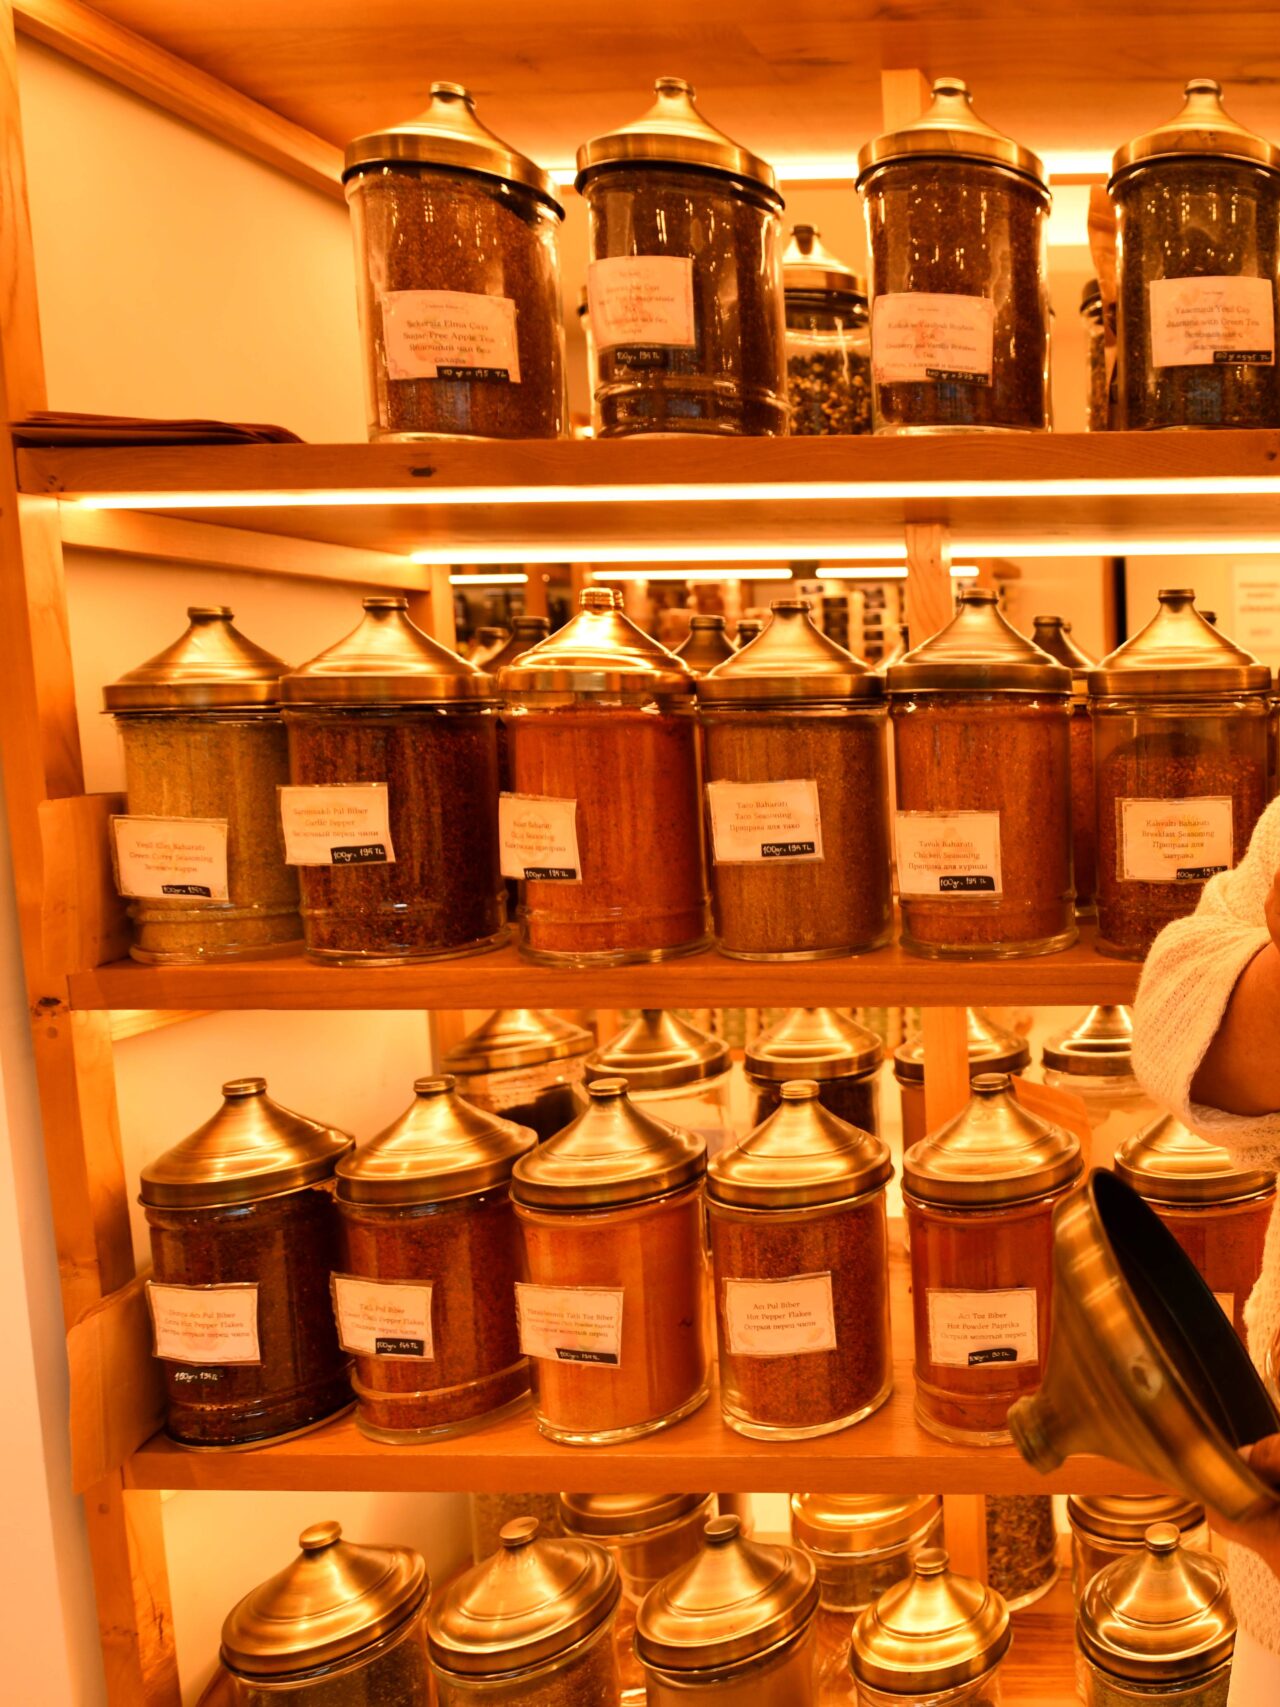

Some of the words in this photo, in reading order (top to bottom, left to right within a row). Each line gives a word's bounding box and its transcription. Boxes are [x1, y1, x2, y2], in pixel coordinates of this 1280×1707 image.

[780, 1301, 801, 1309] Biber
[761, 1312, 786, 1322] Pepper
[788, 1310, 813, 1318] Flakes
[972, 1312, 986, 1320] Toz
[987, 1311, 1008, 1319] Biber
[962, 1322, 990, 1330] Powder
[991, 1320, 1020, 1330] Paprika
